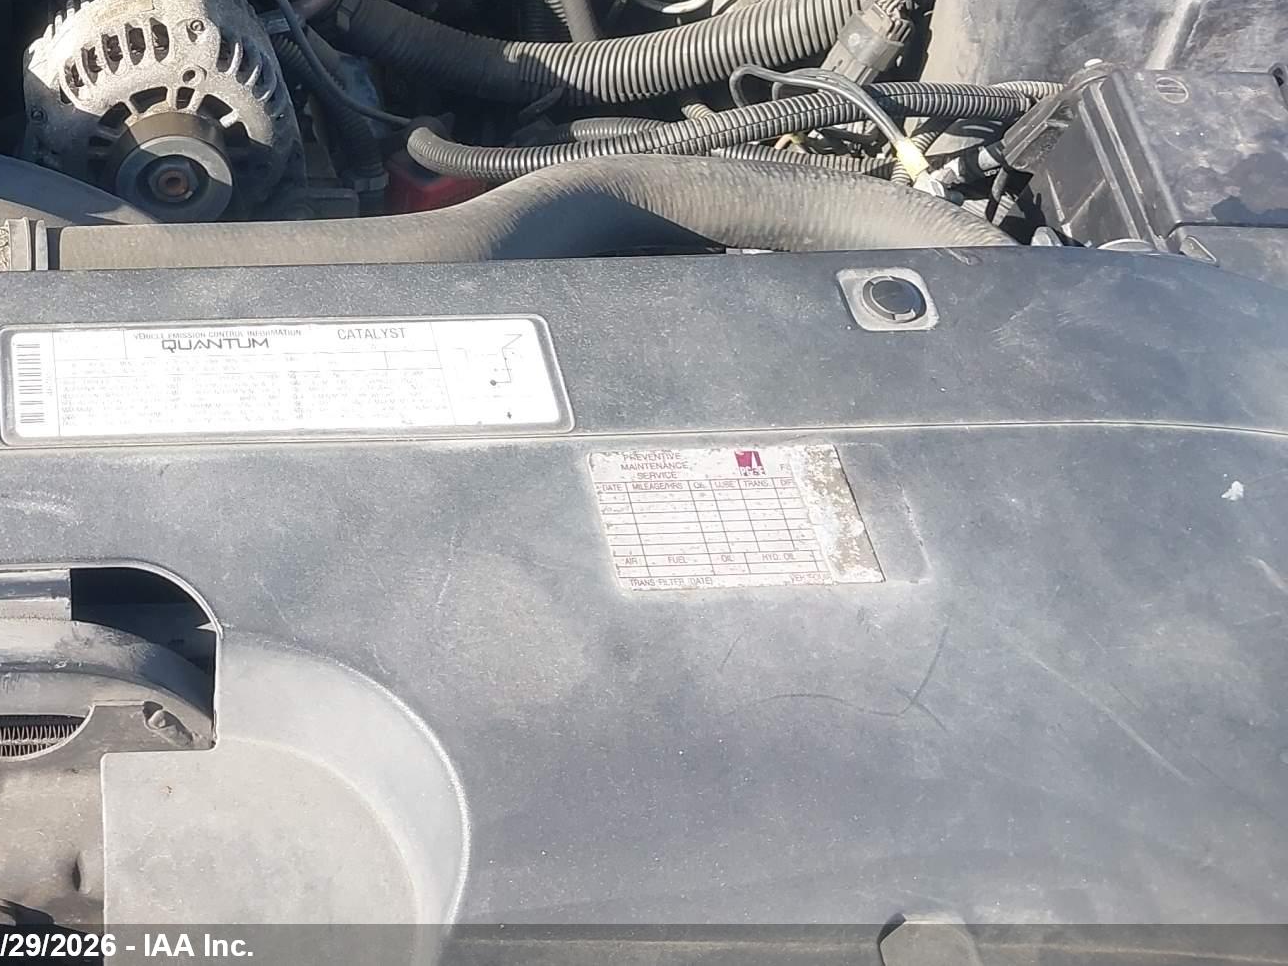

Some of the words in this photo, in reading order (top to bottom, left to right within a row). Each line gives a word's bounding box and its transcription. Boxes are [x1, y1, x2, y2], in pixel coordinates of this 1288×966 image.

[167, 331, 206, 339] EMISSION
[337, 327, 407, 340] CATALYST
[161, 338, 270, 353] QUANTUM
[622, 451, 681, 461] PREVENTIVE
[620, 461, 688, 470] MAINTENANCE
[636, 471, 678, 480] SERVICE
[631, 482, 683, 490] MILEAGE/HRS
[667, 556, 688, 564] FUEL
[630, 578, 656, 586] TRANS
[658, 577, 686, 586] FILTER
